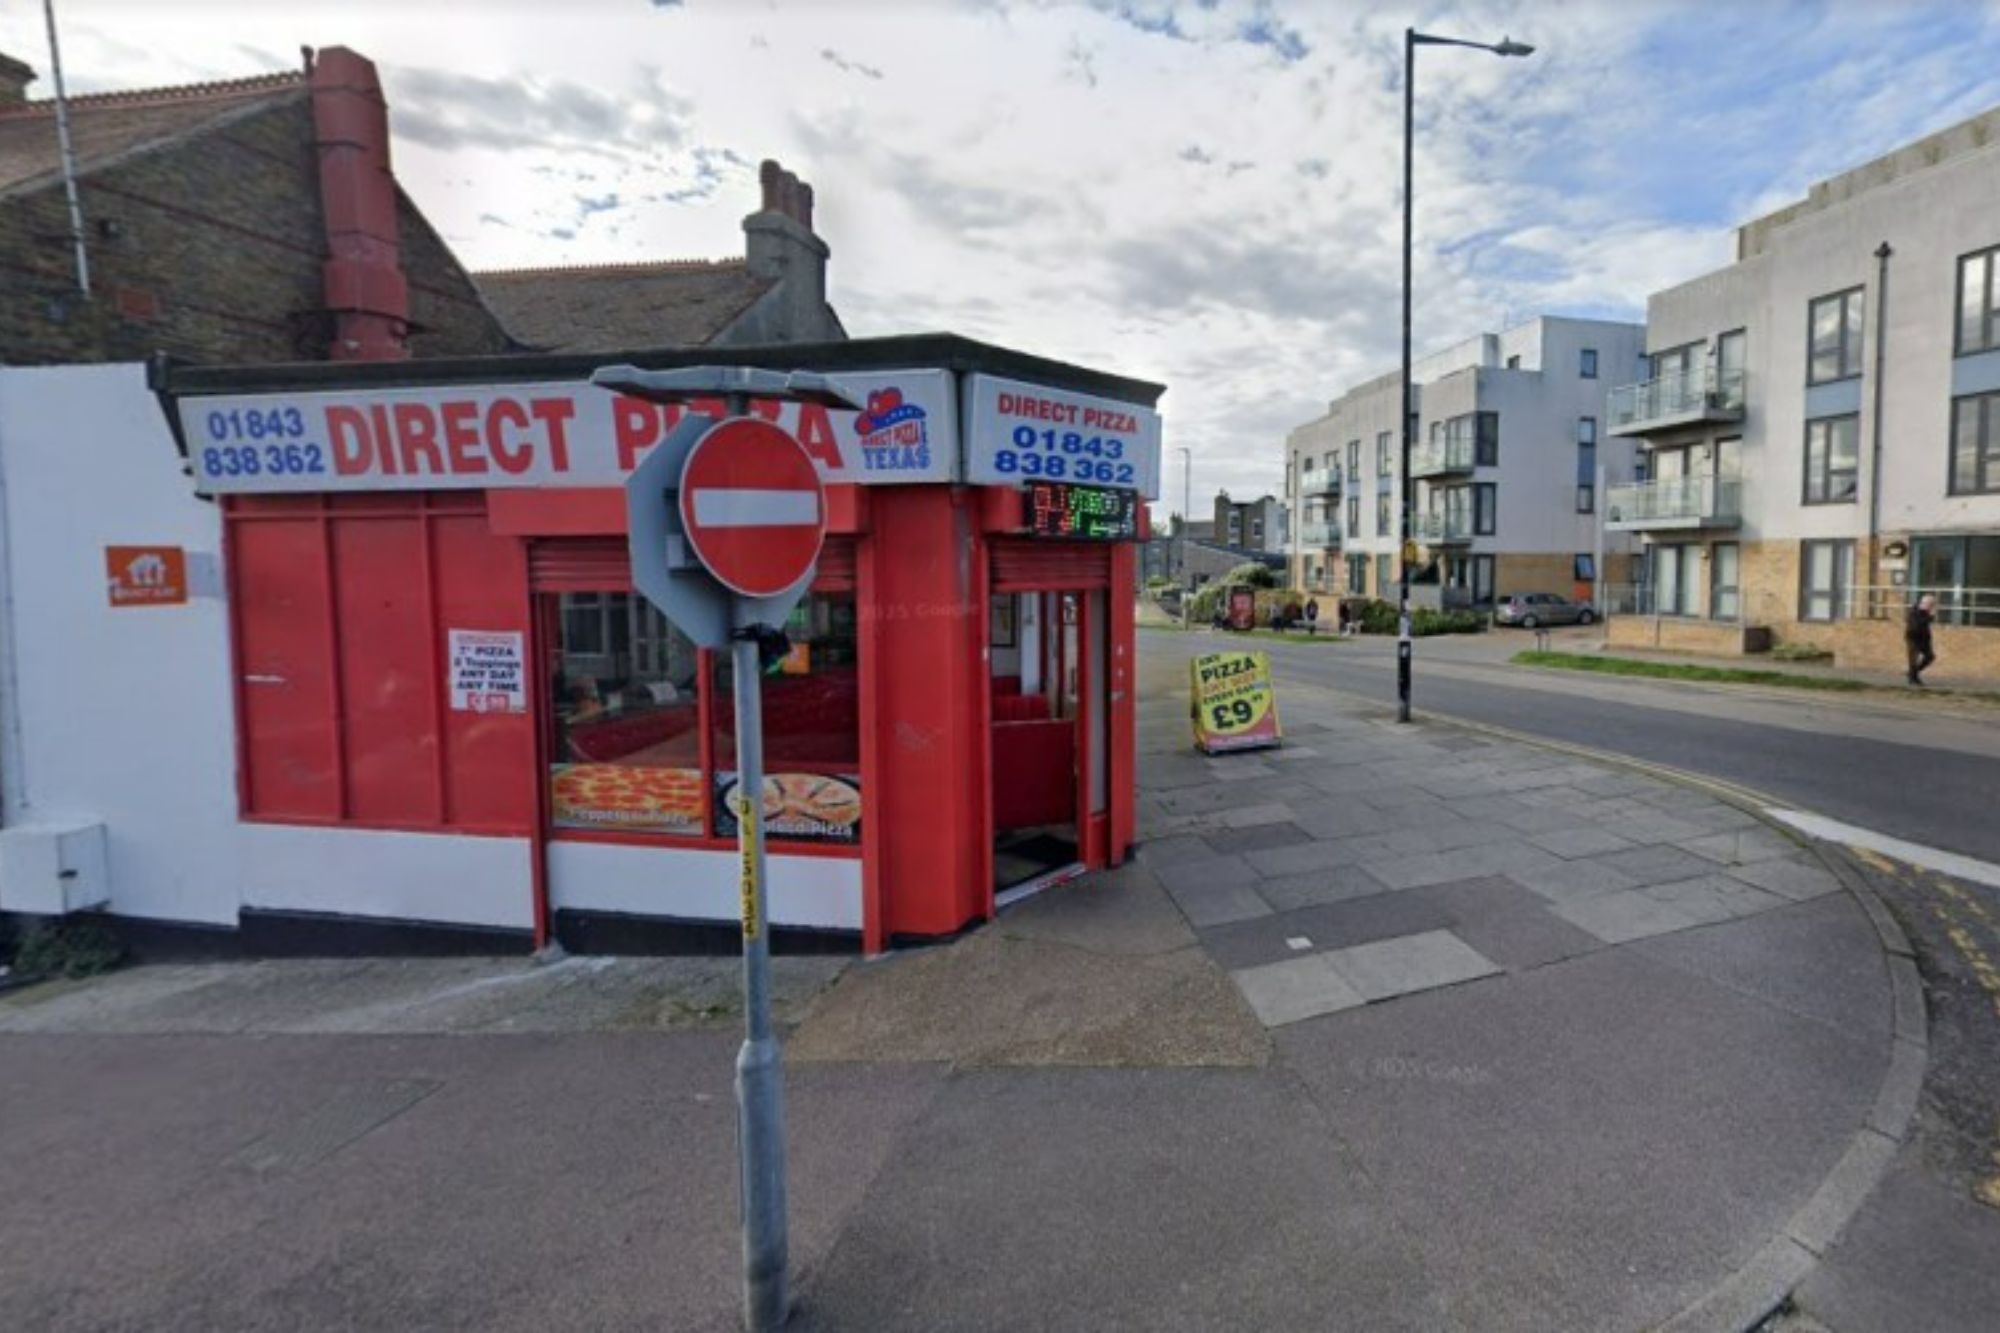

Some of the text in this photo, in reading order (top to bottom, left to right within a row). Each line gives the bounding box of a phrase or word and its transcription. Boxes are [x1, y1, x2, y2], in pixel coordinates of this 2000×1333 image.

[207, 407, 305, 440] 01843
[998, 393, 1138, 433] DIRECT PIZZA
[324, 396, 574, 476] DIRECT
[1013, 425, 1124, 459] 01843
[203, 444, 324, 477] 838 362
[864, 446, 931, 470] TEXAS
[994, 449, 1134, 484] 838 362
[1201, 656, 1257, 683] PIZZA
[1212, 699, 1253, 729] £9
